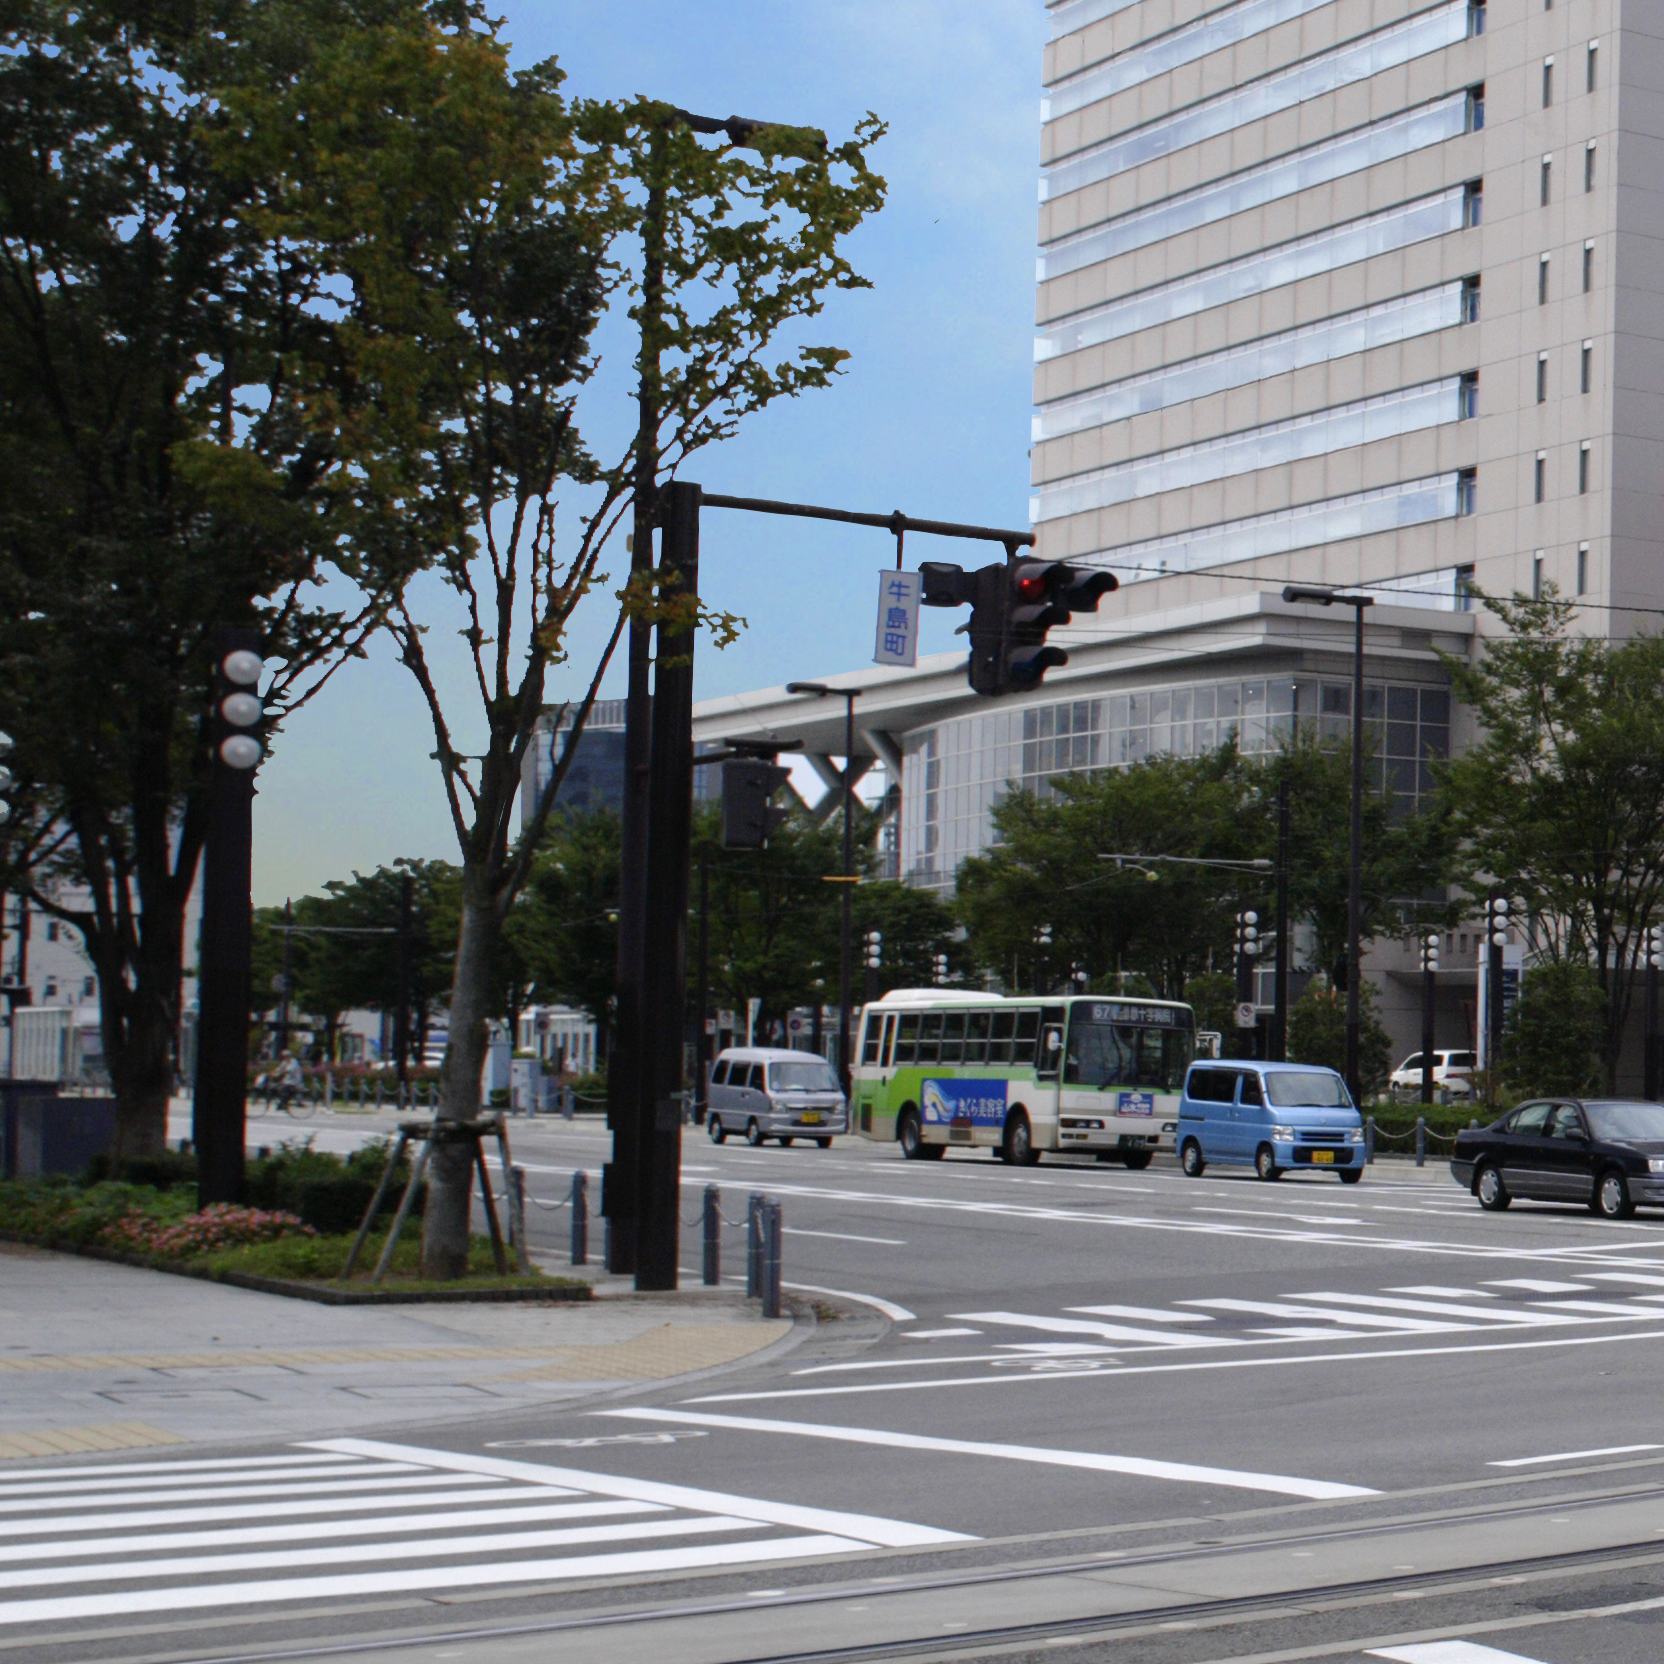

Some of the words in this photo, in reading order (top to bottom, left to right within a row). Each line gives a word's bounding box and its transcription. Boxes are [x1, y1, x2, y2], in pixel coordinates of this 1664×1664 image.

[884, 580, 911, 656] 牛島町
[1094, 1004, 1110, 1019] 67
